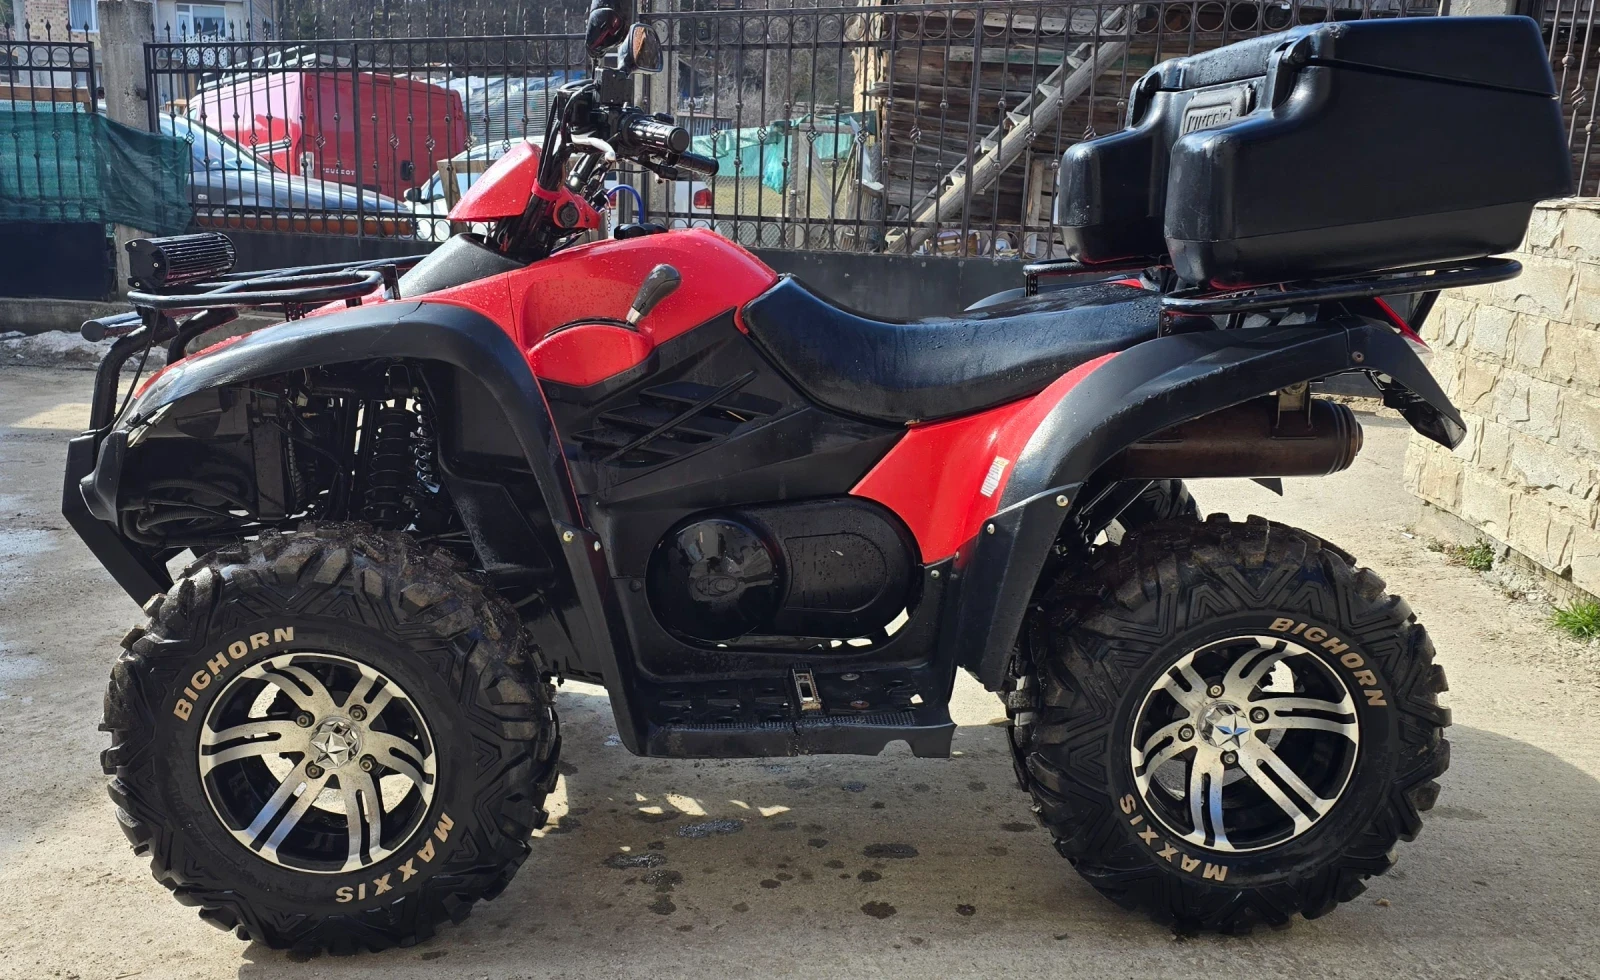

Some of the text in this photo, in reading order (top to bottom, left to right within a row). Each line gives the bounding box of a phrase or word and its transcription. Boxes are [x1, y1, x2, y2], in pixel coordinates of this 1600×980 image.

[173, 626, 294, 721] BIGHORN
[1268, 617, 1387, 706] BIGHORN
[335, 812, 455, 903] MAXXIS
[1119, 793, 1228, 882] MAXXIS
